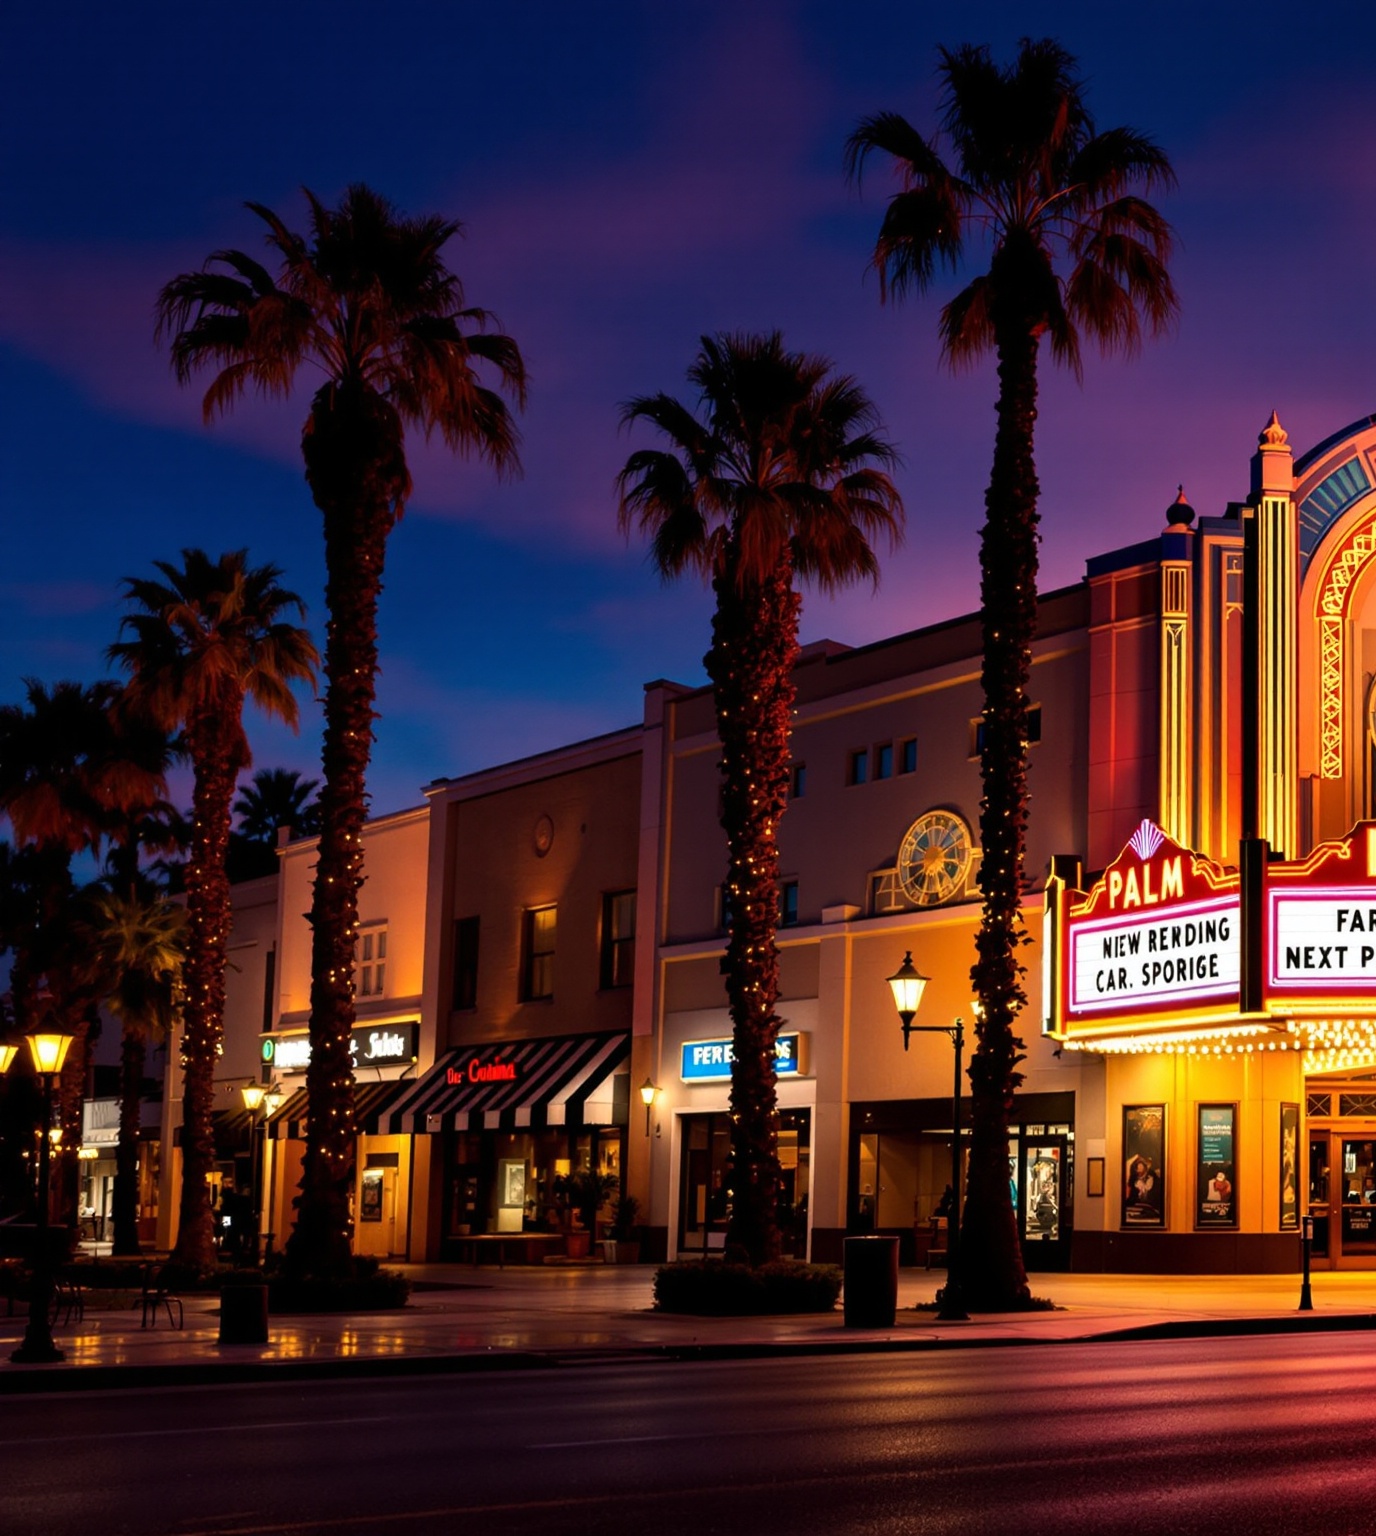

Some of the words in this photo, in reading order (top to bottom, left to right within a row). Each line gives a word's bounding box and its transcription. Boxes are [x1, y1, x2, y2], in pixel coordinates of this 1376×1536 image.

[1108, 855, 1185, 910] PALM
[1096, 967, 1133, 993] CAR.
[1141, 953, 1219, 987] SPORIGE
[1286, 946, 1349, 969] NEXT
